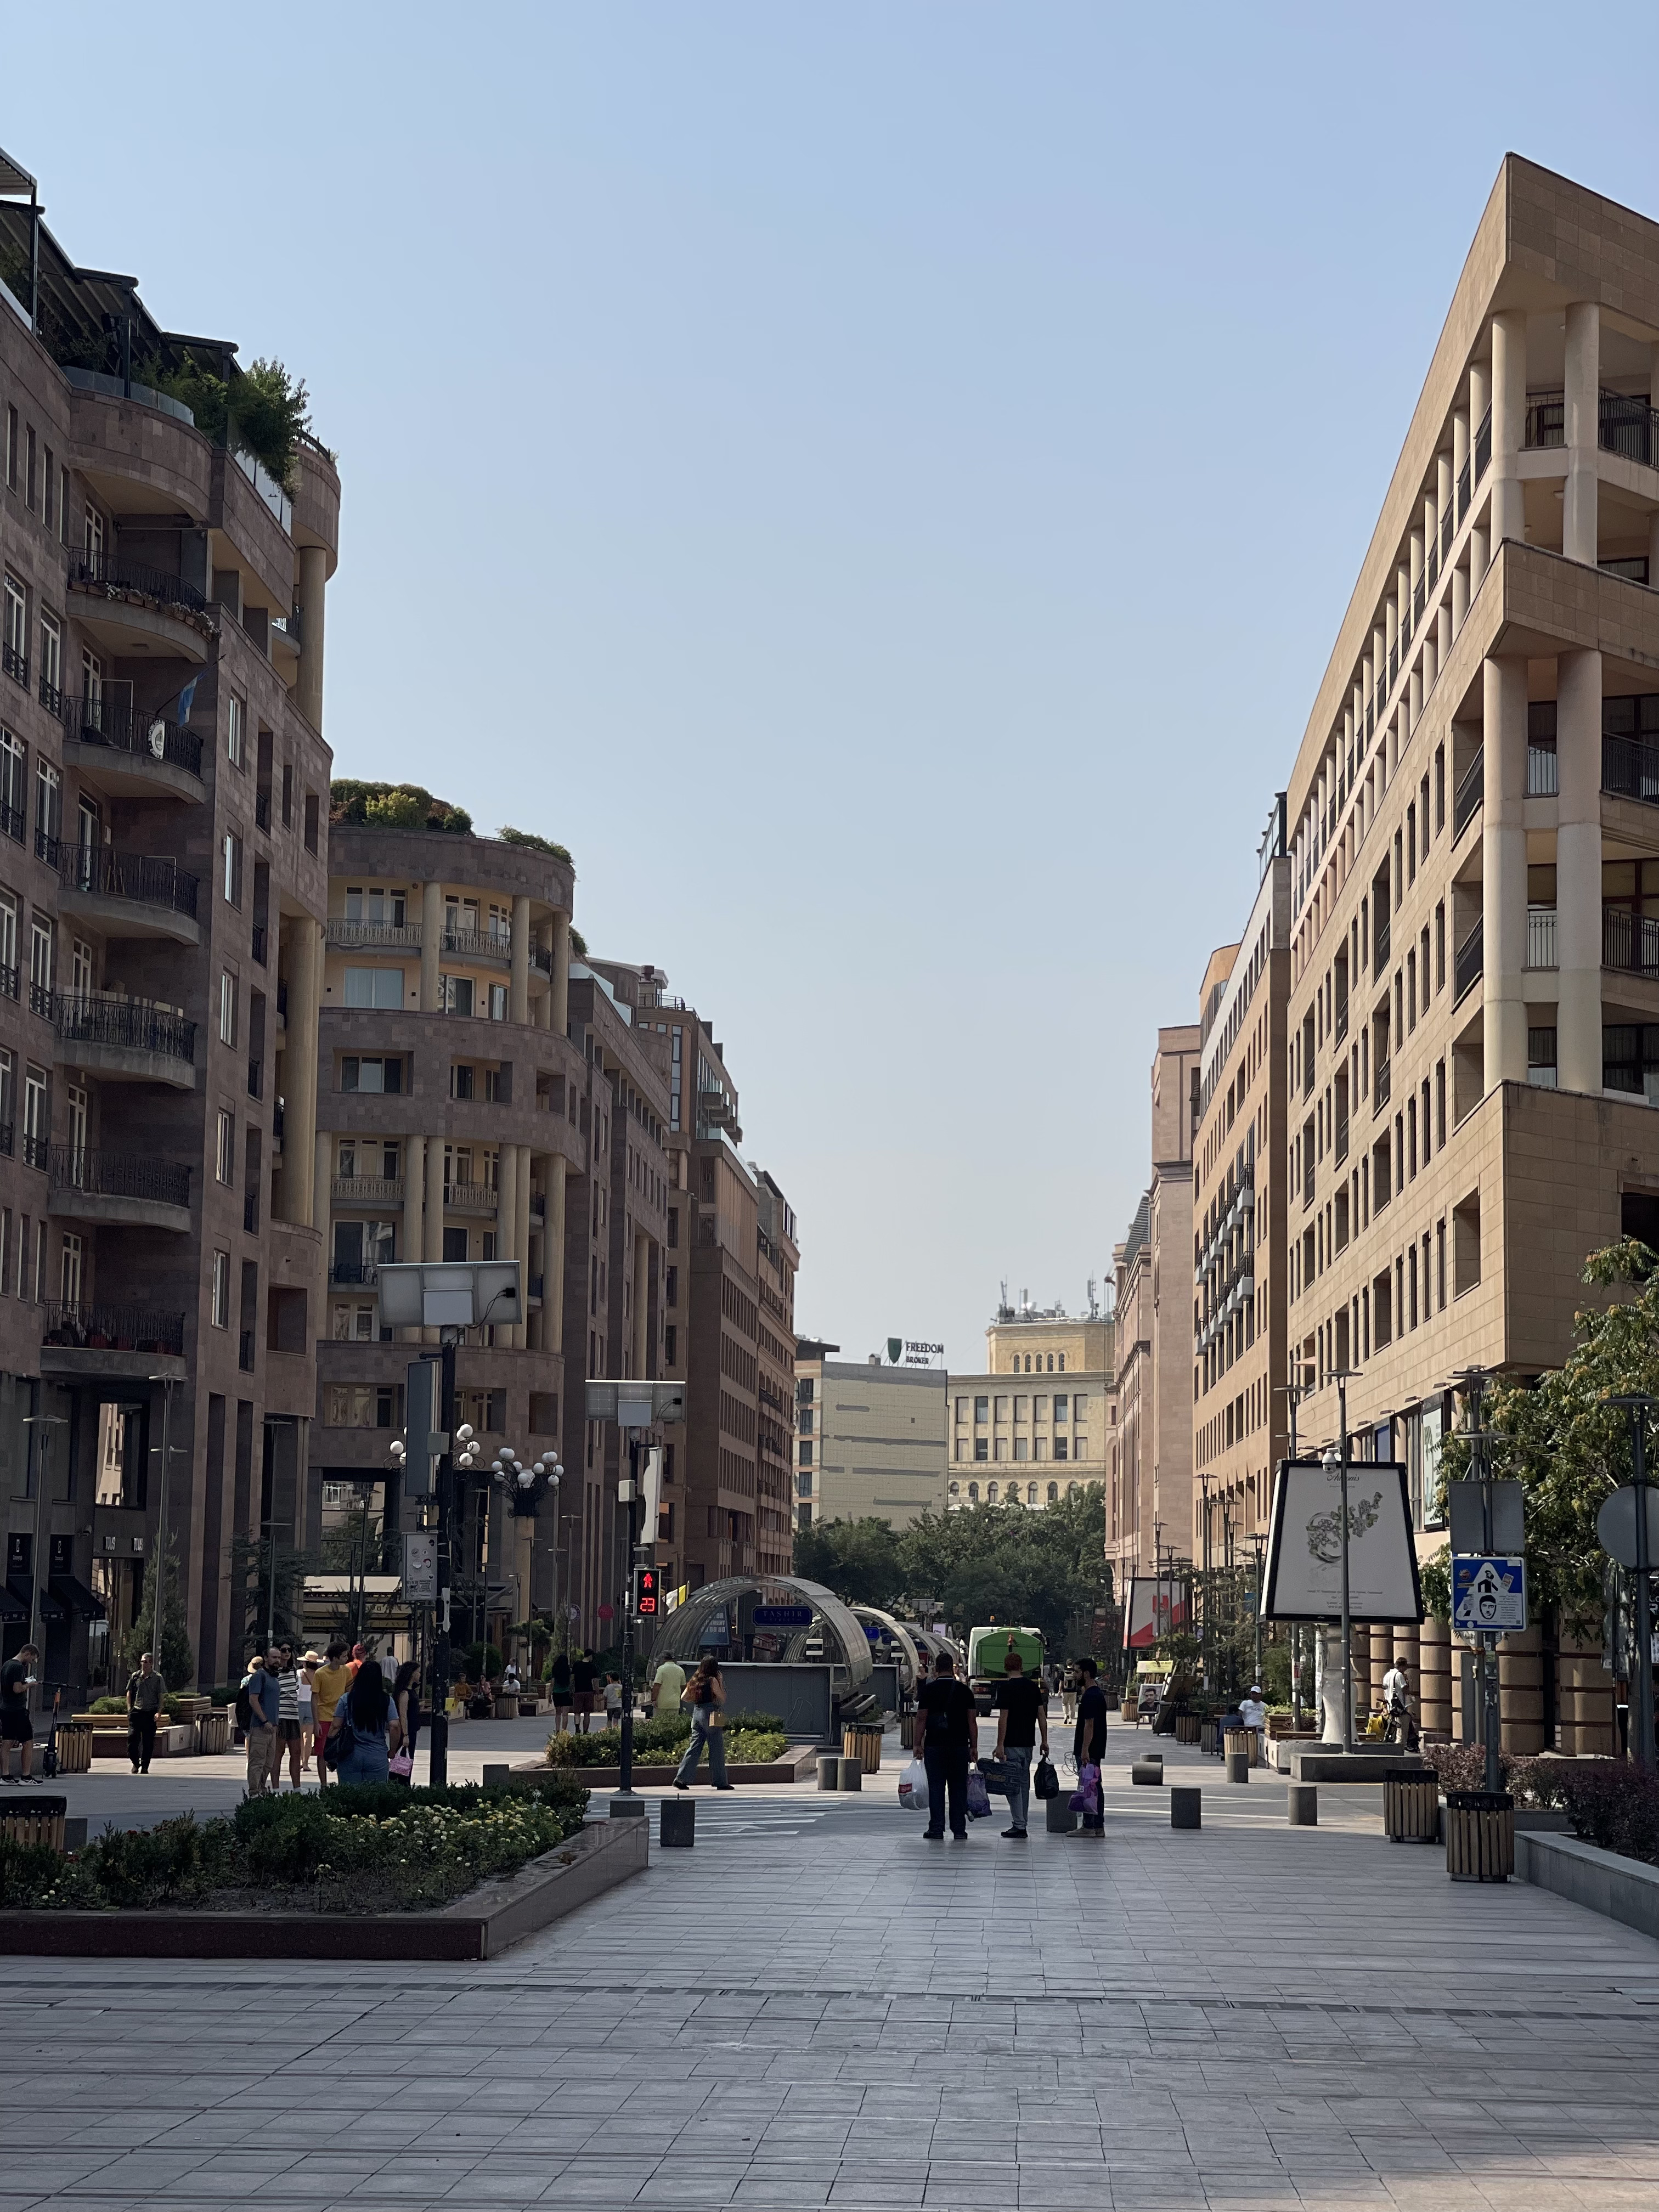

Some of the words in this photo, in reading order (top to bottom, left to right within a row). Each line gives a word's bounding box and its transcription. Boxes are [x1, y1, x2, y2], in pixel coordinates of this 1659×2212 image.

[906, 1342, 944, 1354] FREEDOM
[906, 1356, 929, 1364] BROKER
[640, 1598, 655, 1611] 23
